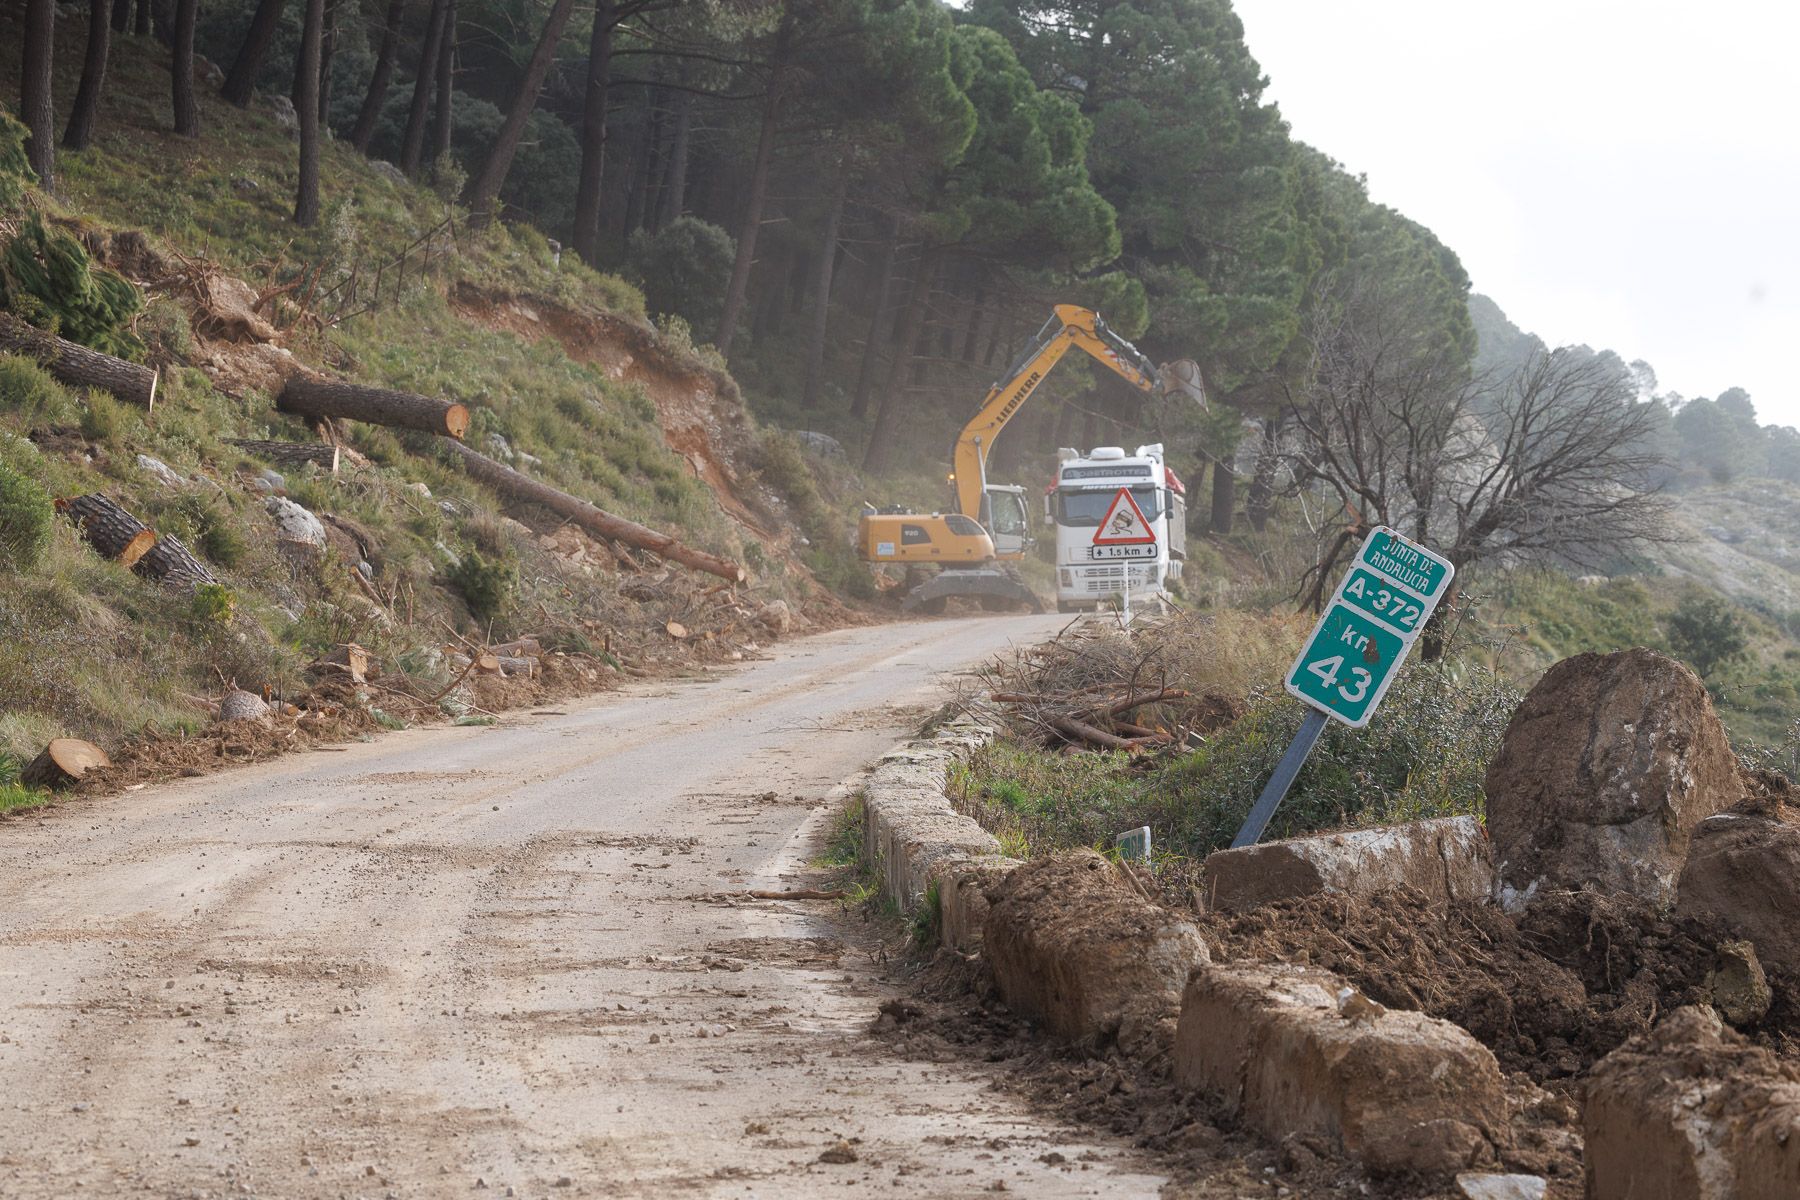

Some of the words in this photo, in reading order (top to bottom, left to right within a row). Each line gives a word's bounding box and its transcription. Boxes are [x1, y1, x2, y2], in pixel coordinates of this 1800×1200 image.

[996, 371, 1041, 423] LIEBHERR
[1124, 546, 1141, 556] km
[1382, 537, 1417, 566] JUNTA
[1419, 557, 1437, 575] DE
[1347, 577, 1420, 626] A-372
[1307, 655, 1372, 702] 43
